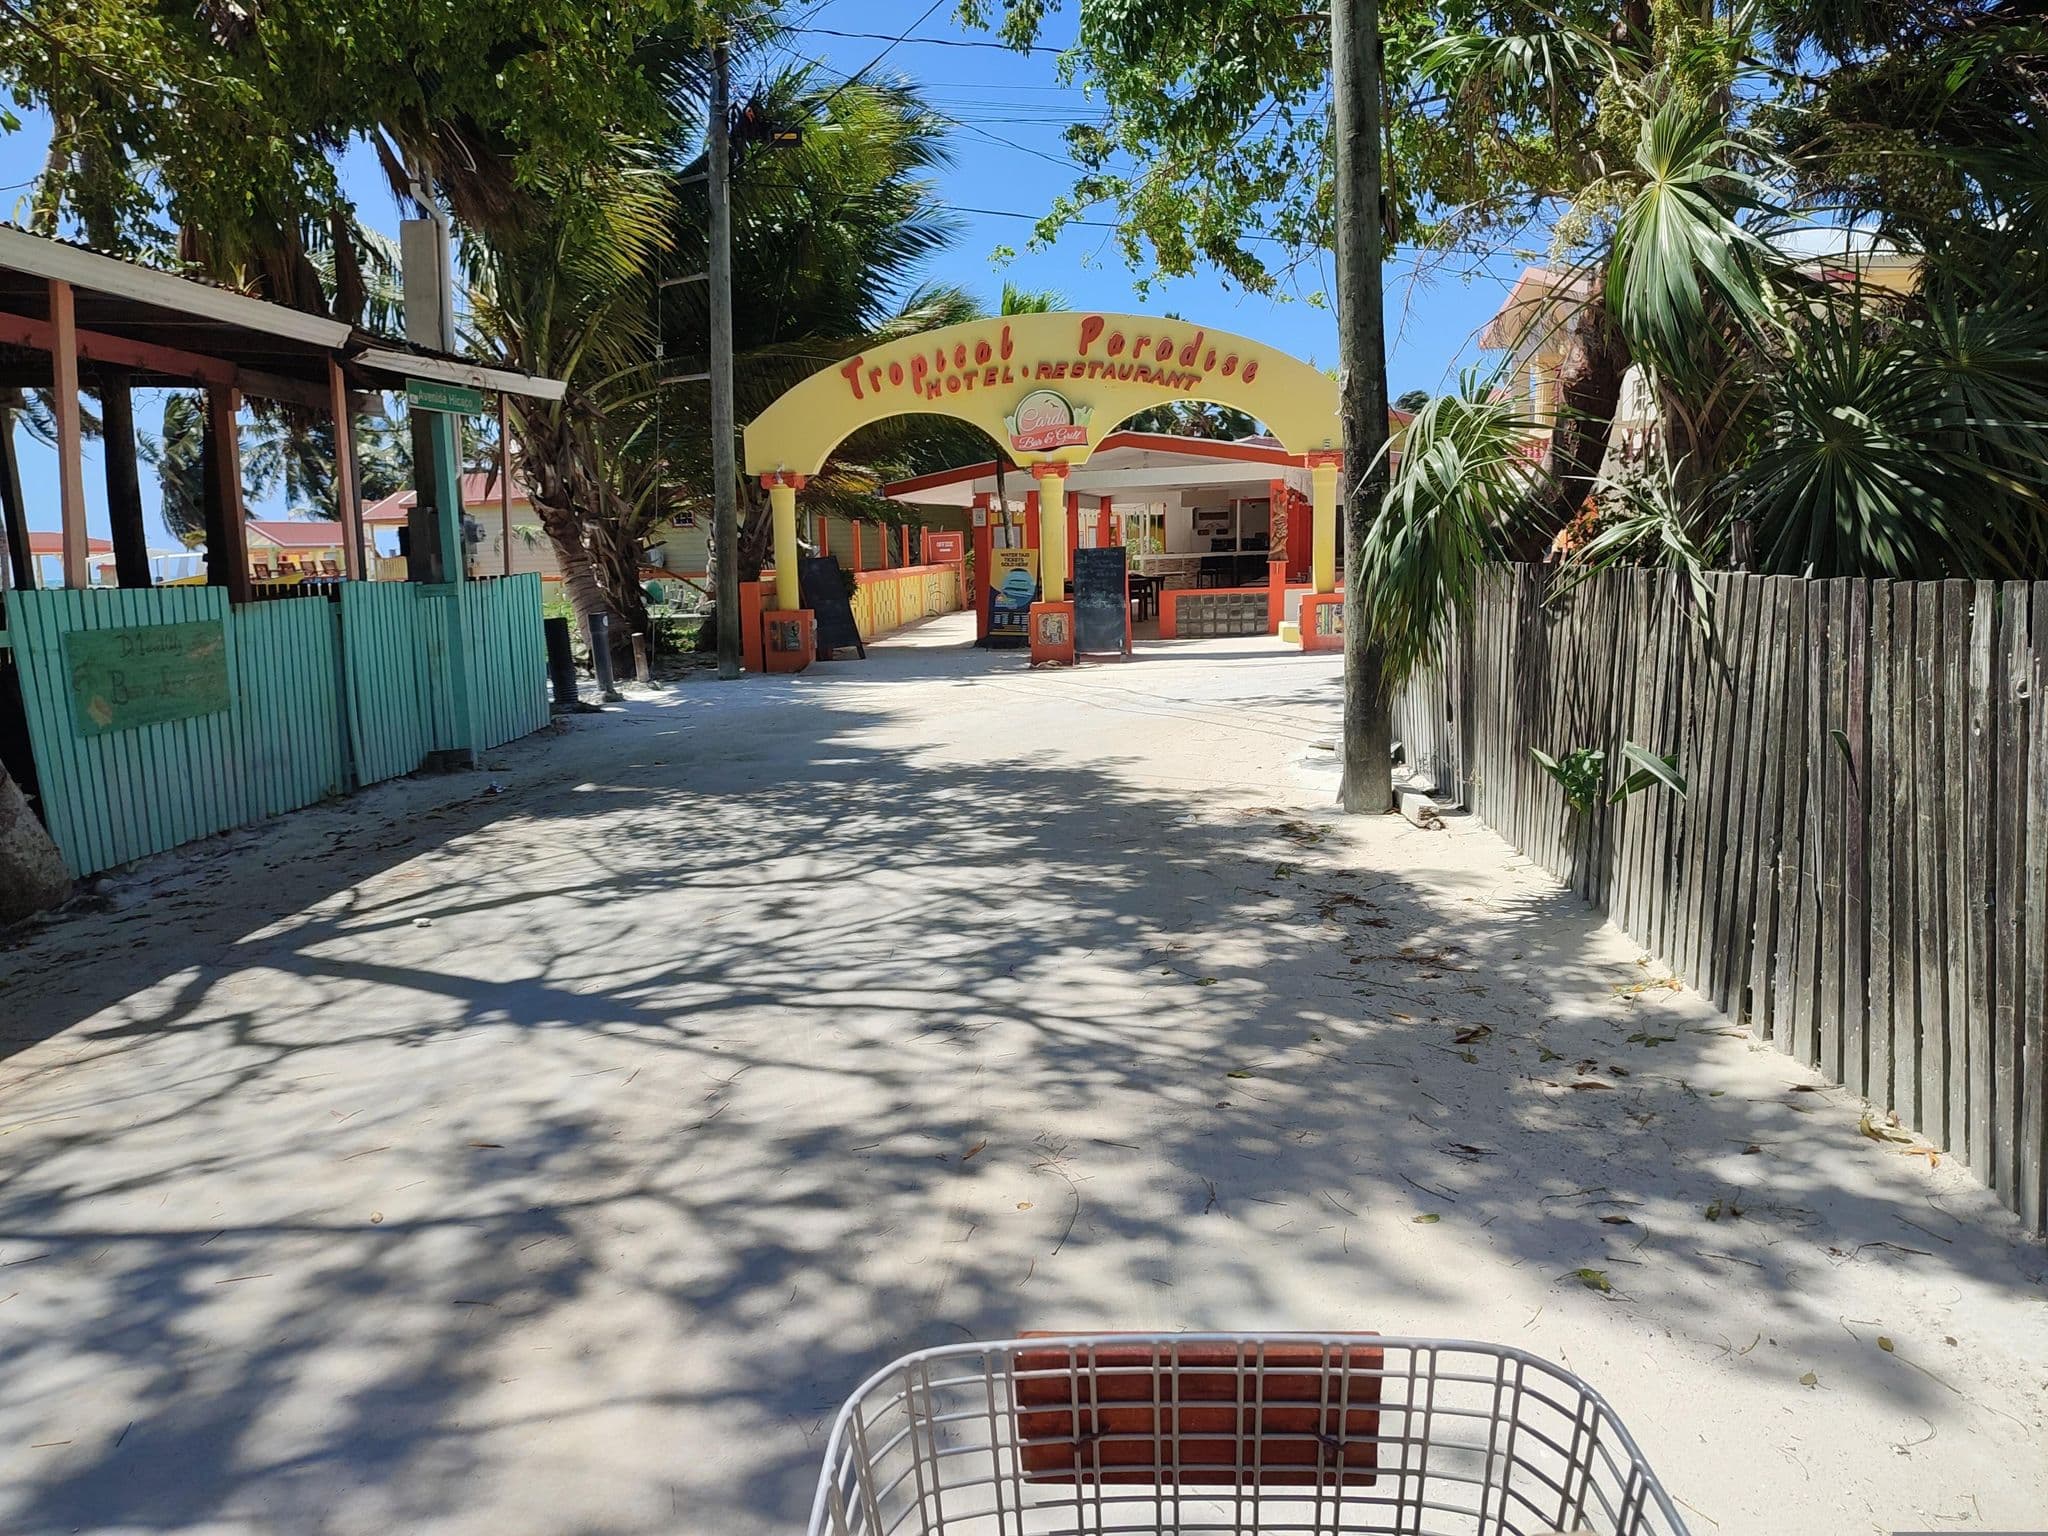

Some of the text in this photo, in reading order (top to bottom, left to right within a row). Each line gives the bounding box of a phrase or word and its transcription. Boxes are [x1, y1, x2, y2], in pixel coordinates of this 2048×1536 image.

[841, 315, 1259, 400] Tropical Paradise
[926, 361, 1202, 400] HOTEL RESTAURANT
[418, 388, 448, 404] Avenida
[1019, 428, 1082, 448] Bar & Grill
